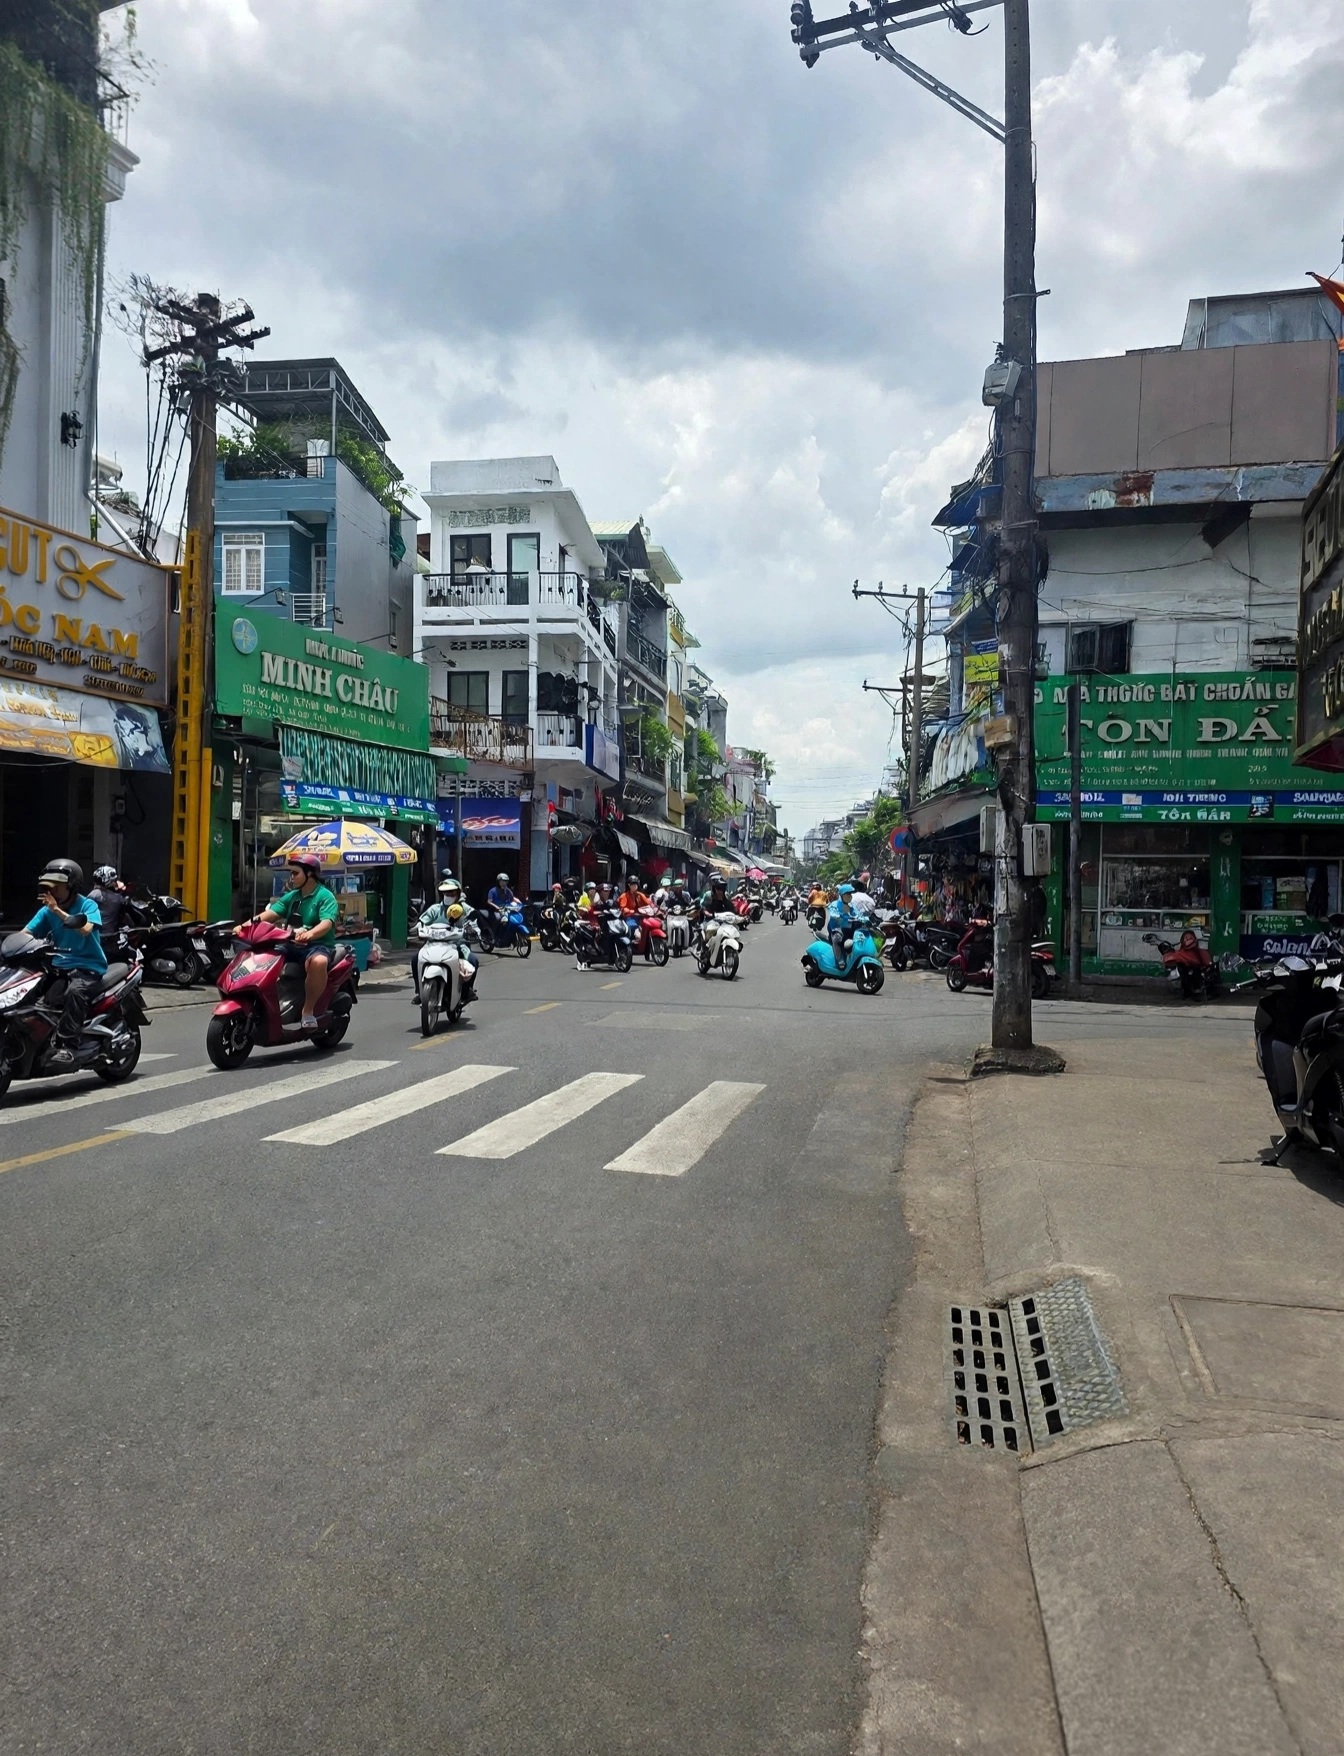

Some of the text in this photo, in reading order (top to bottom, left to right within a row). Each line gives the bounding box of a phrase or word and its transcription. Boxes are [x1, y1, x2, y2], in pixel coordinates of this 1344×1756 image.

[52, 612, 139, 660] NAM
[261, 651, 332, 698] MINH
[336, 677, 399, 714] CHÂU
